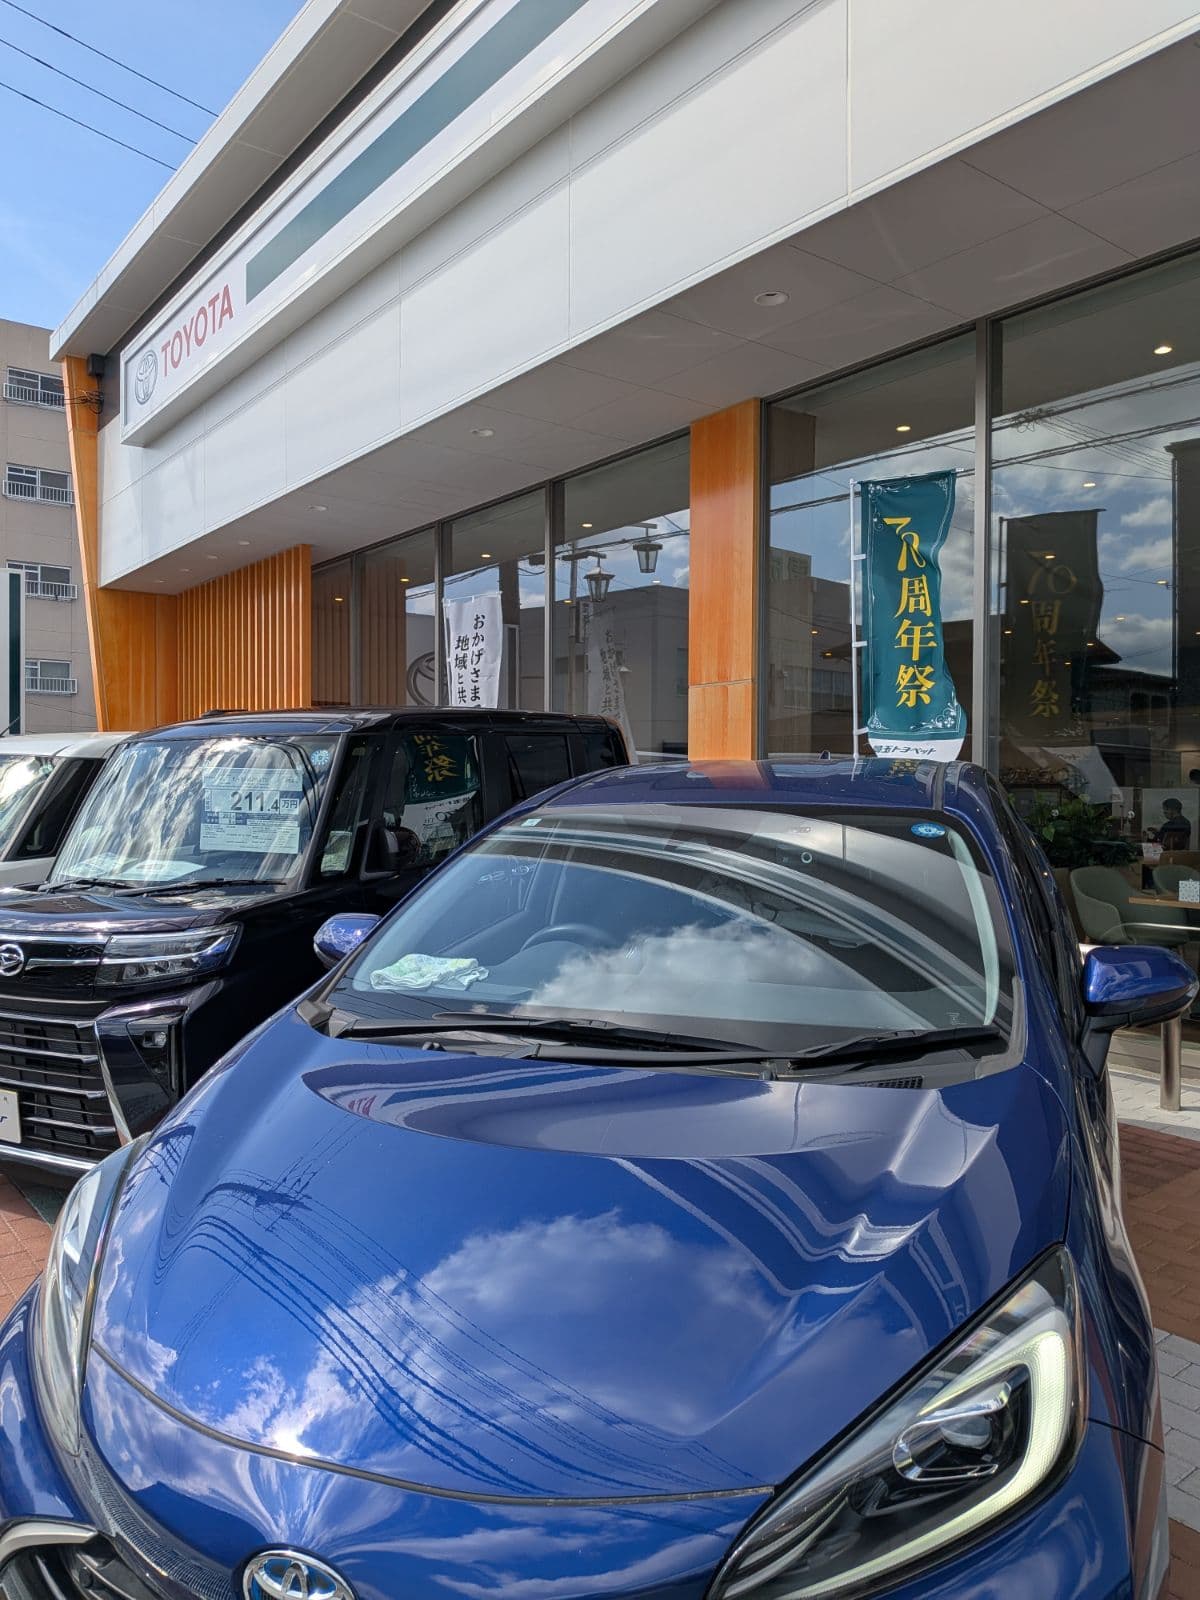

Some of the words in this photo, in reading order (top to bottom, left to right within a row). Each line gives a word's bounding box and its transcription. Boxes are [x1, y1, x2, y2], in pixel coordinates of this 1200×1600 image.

[161, 284, 234, 377] TOYOTA
[470, 613, 486, 707] おかげさま
[230, 791, 280, 812] 211.4
[281, 799, 298, 809] 万円
